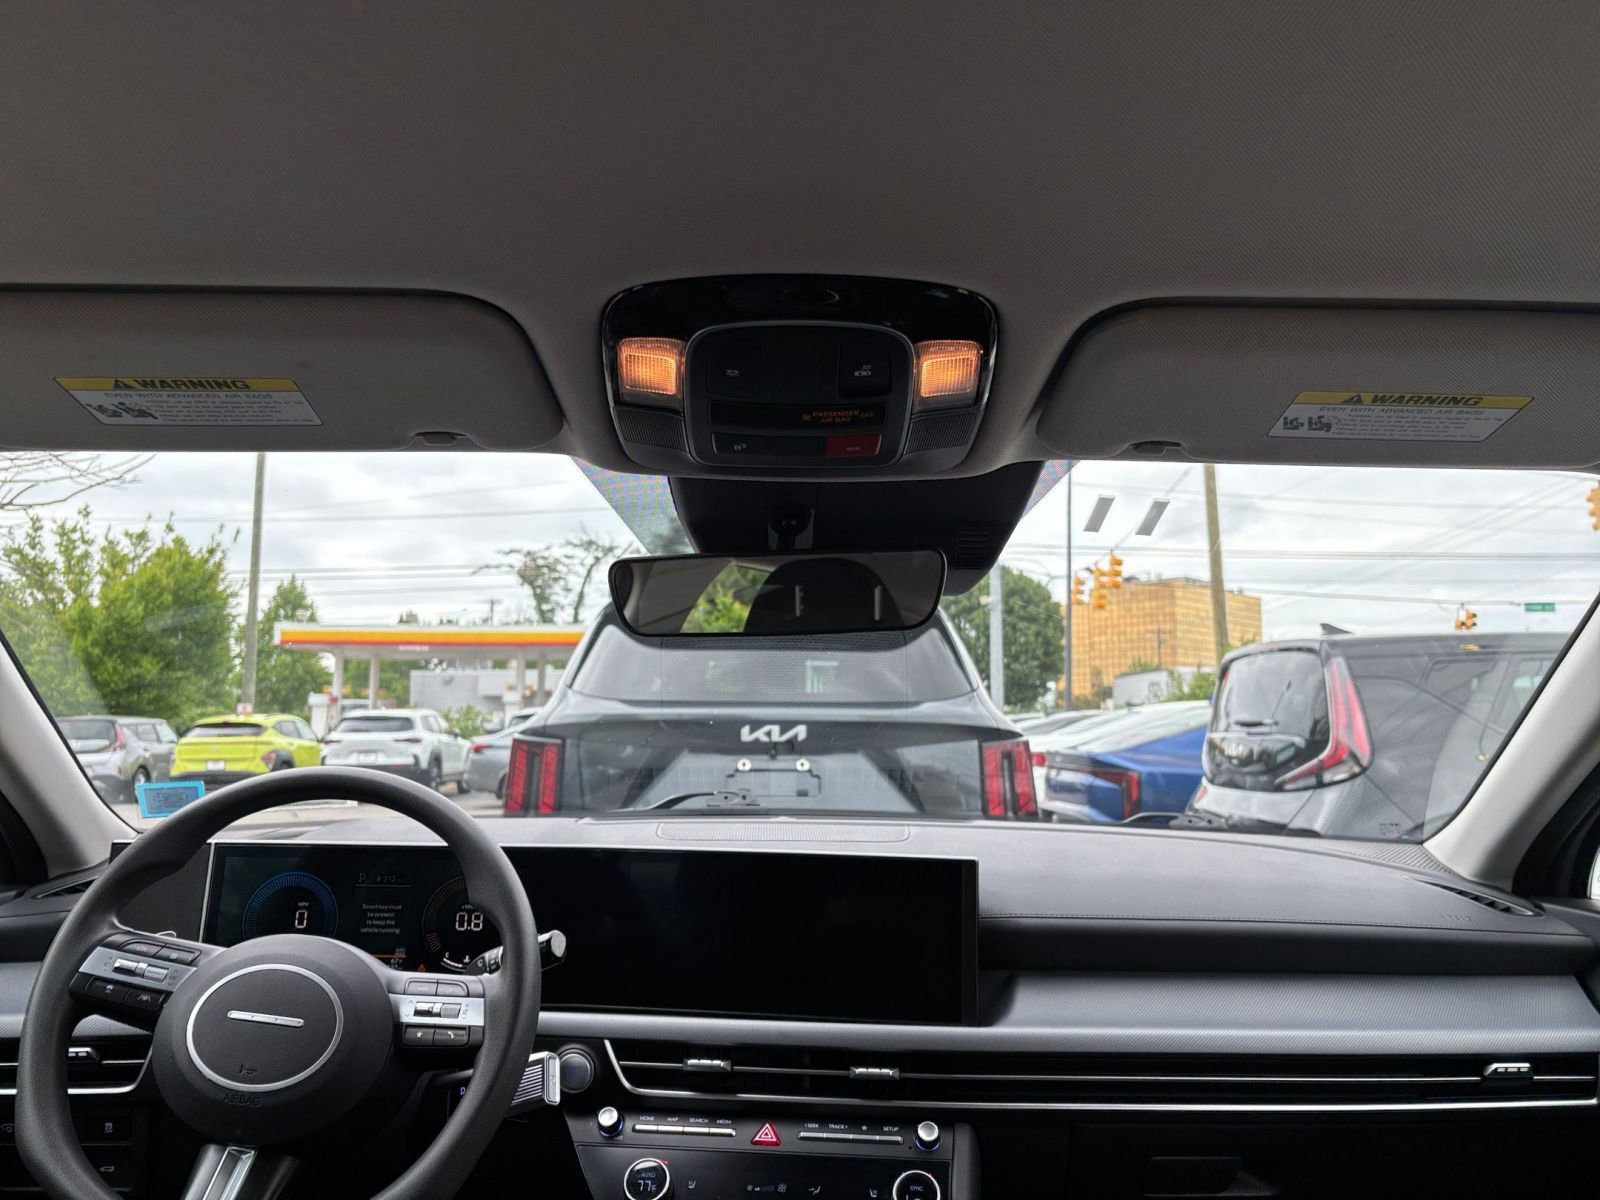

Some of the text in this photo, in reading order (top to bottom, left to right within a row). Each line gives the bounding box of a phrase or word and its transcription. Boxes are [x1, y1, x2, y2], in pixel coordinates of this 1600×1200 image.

[133, 379, 251, 389] WARNING
[1371, 394, 1483, 406] WARNING
[740, 723, 808, 742] KIA
[295, 909, 308, 929] 0
[455, 911, 483, 931] 0.8
[222, 1093, 261, 1107] AIRBAG
